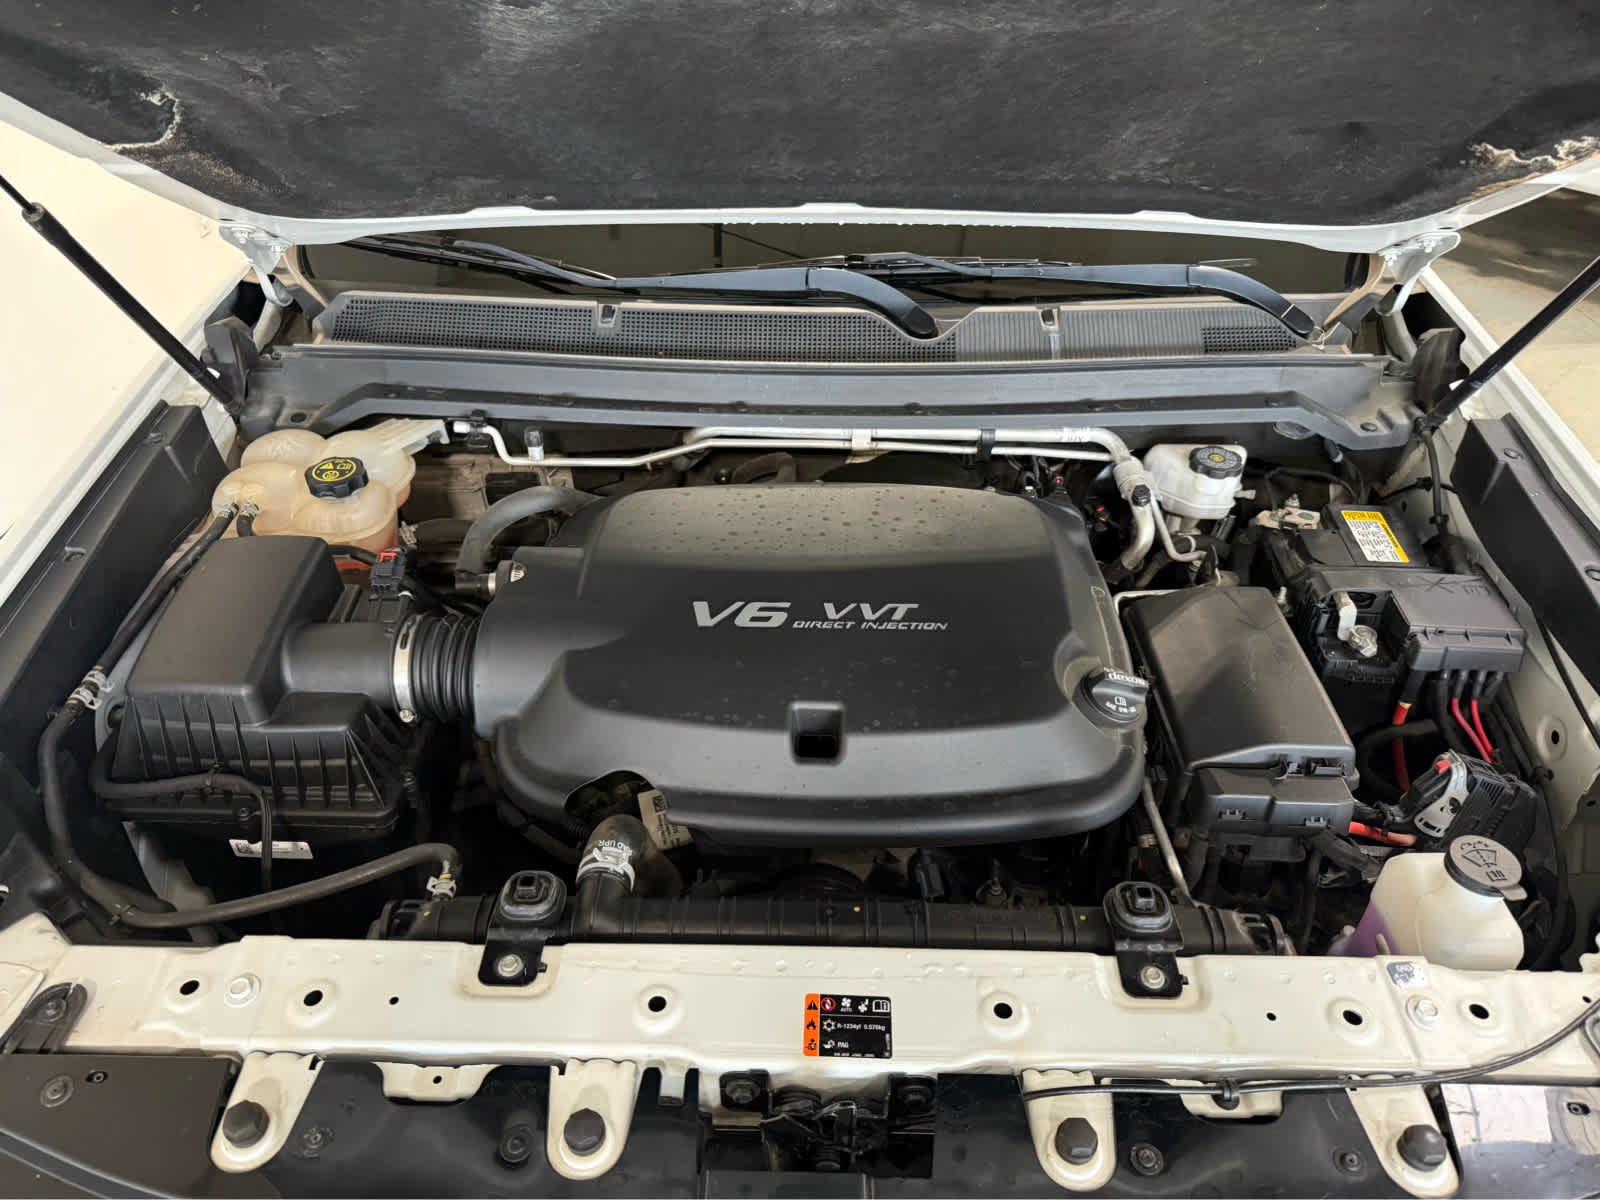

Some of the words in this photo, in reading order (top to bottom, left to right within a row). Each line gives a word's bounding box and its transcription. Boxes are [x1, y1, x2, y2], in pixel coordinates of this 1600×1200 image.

[692, 601, 792, 628] V6
[823, 602, 919, 621] VVT
[792, 620, 856, 629] DIRECT
[861, 621, 949, 631] INJECTION
[836, 1022, 862, 1031] R-1234yf
[837, 1041, 849, 1049] PAG
